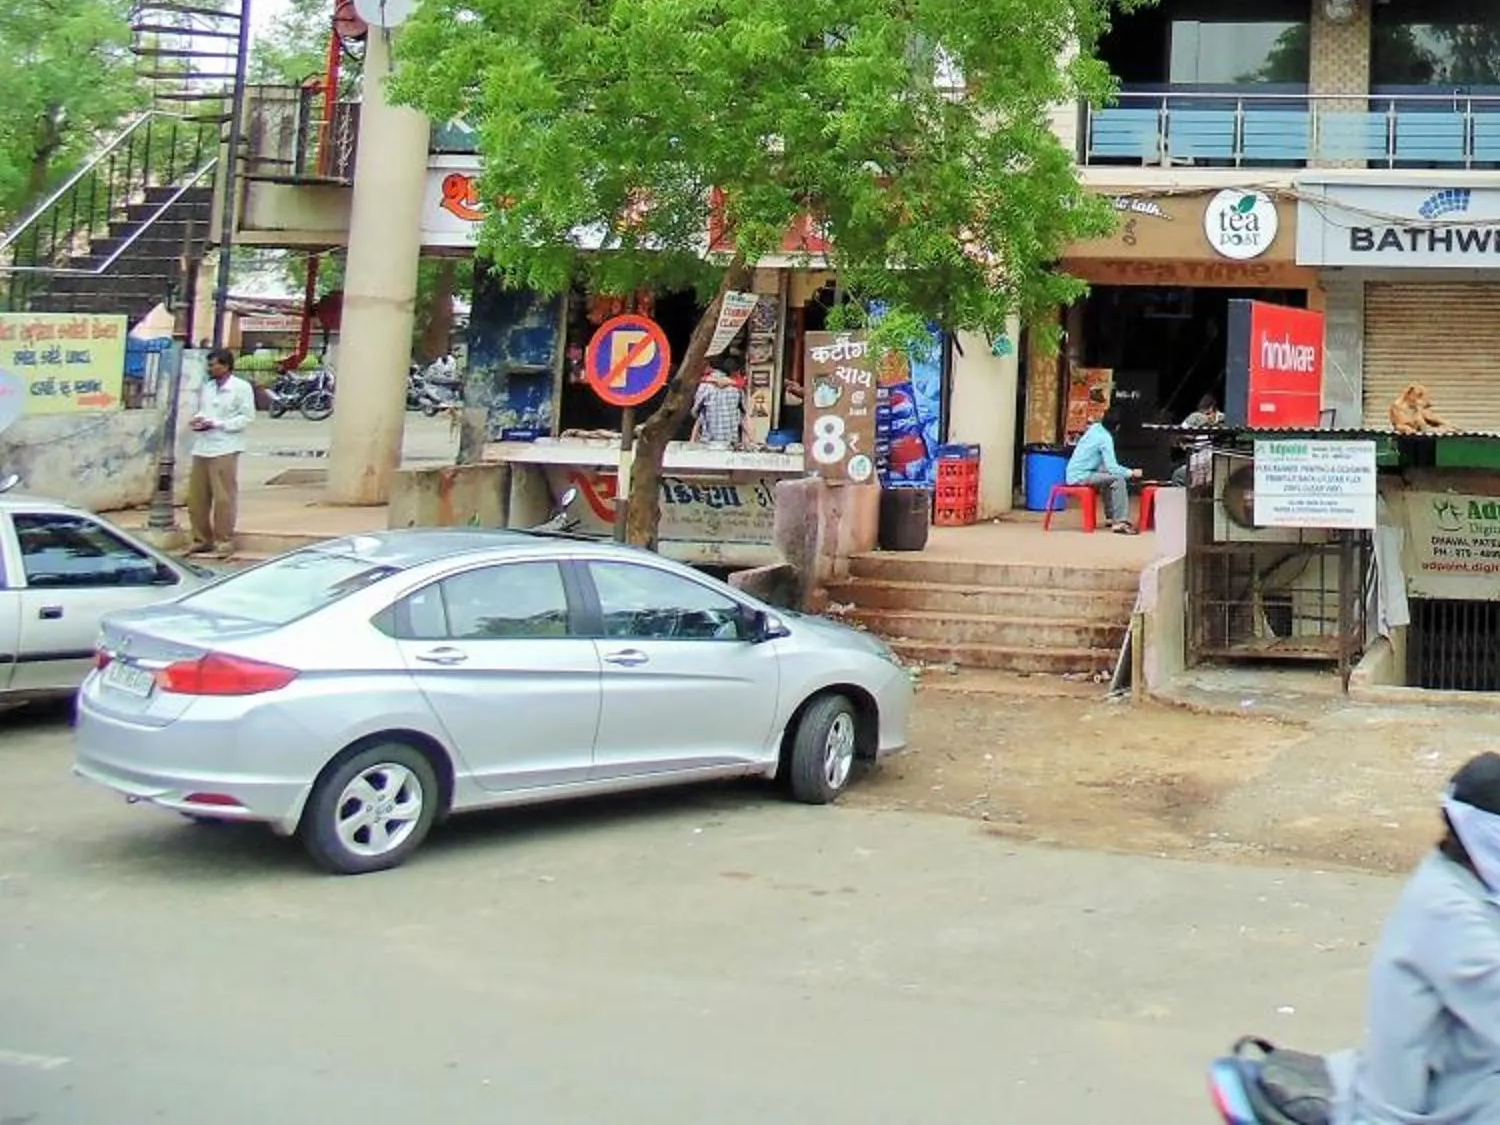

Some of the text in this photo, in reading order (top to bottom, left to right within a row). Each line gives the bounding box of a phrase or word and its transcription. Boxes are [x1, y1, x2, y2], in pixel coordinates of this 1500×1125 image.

[1219, 206, 1260, 233] tea
[1260, 329, 1316, 373] hindware
[812, 414, 846, 465] 8
